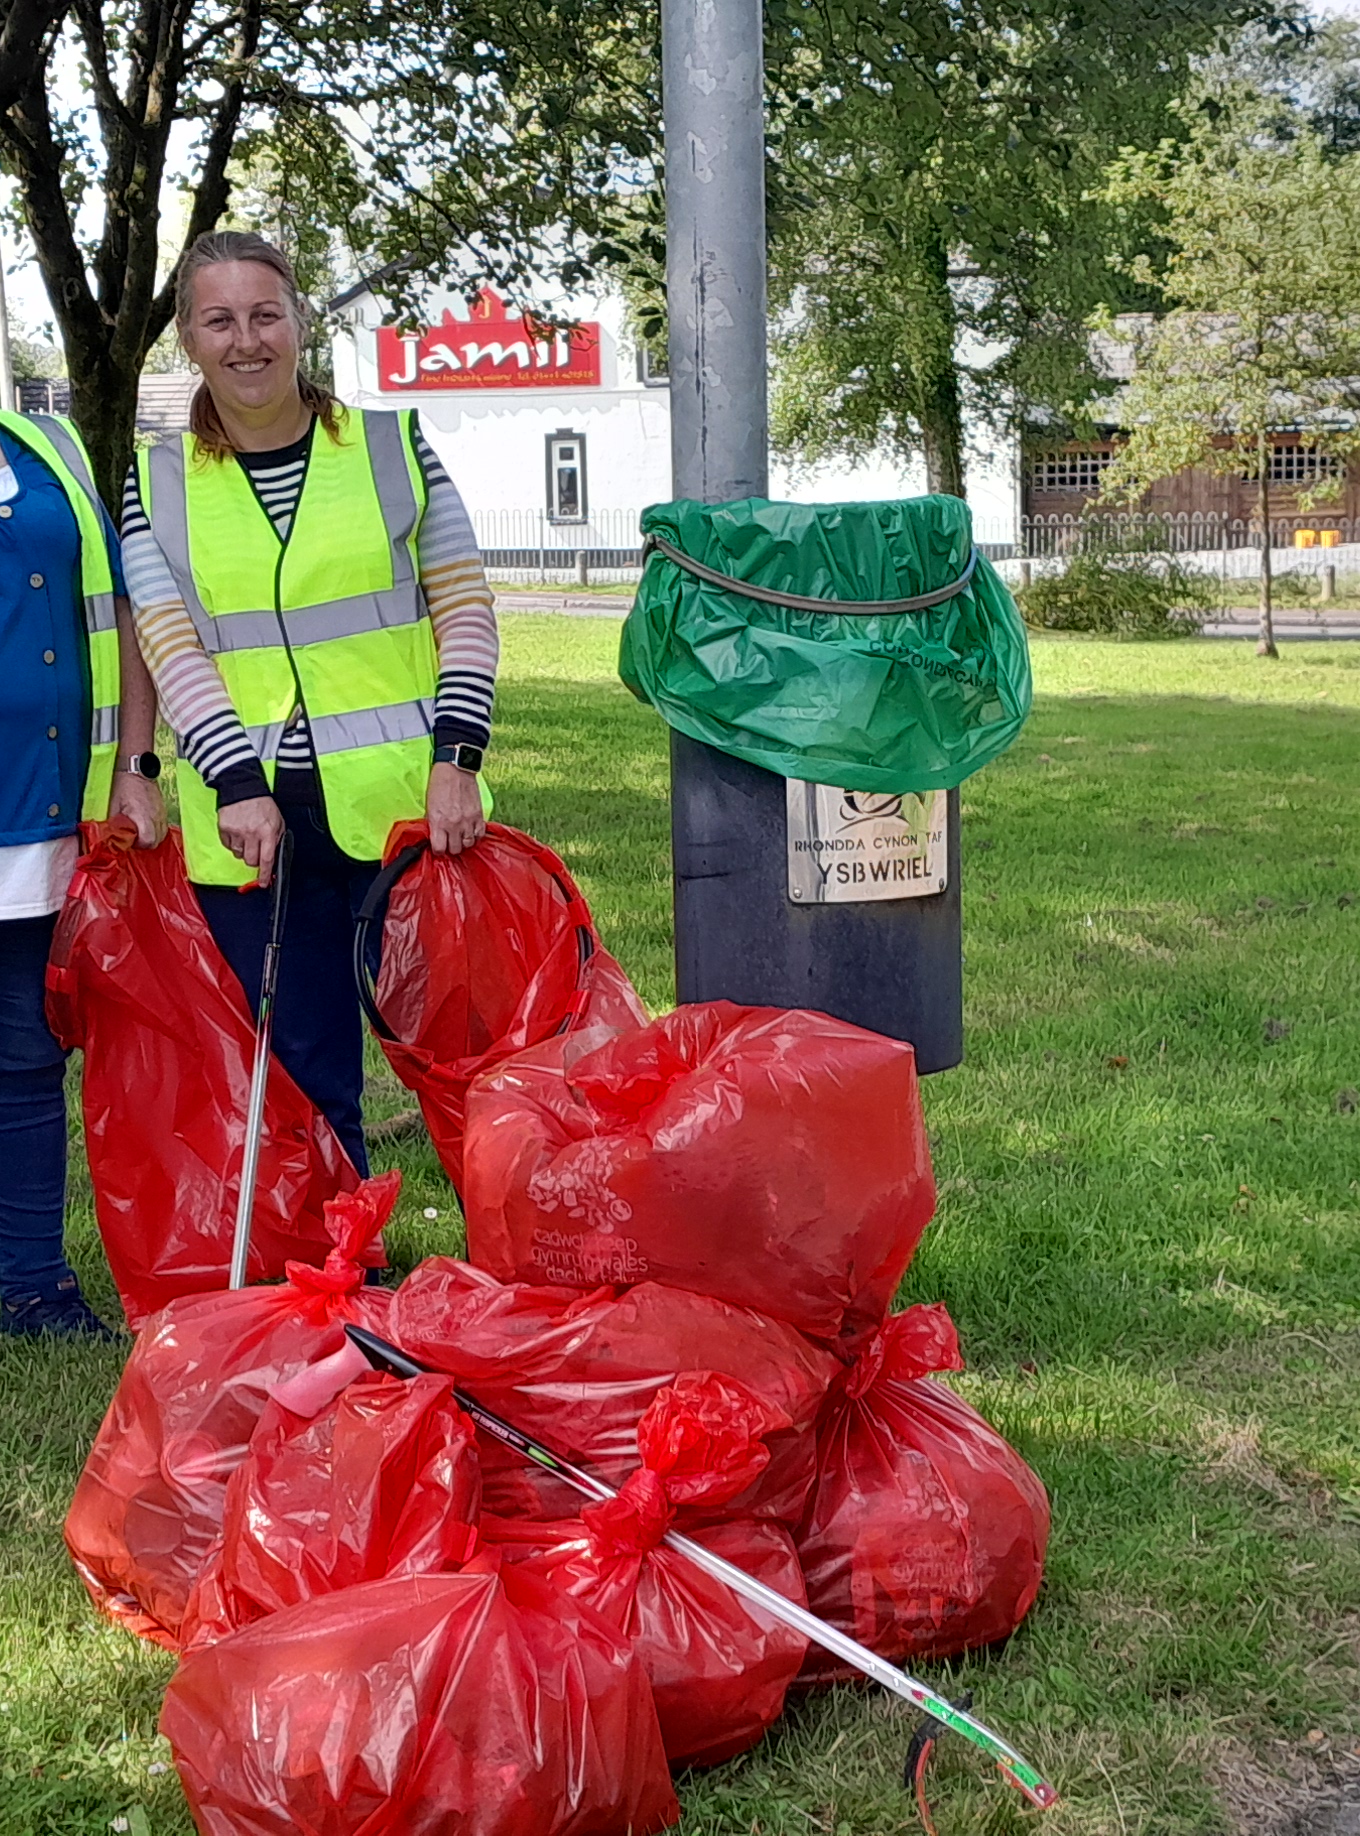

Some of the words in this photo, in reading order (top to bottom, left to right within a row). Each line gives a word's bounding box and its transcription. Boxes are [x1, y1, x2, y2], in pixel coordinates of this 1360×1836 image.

[794, 837, 866, 852] RHONDDA
[873, 833, 918, 850] CYNON
[925, 830, 943, 844] TAF
[817, 856, 933, 885] YSBWRIEL
[599, 1253, 649, 1273] wales
